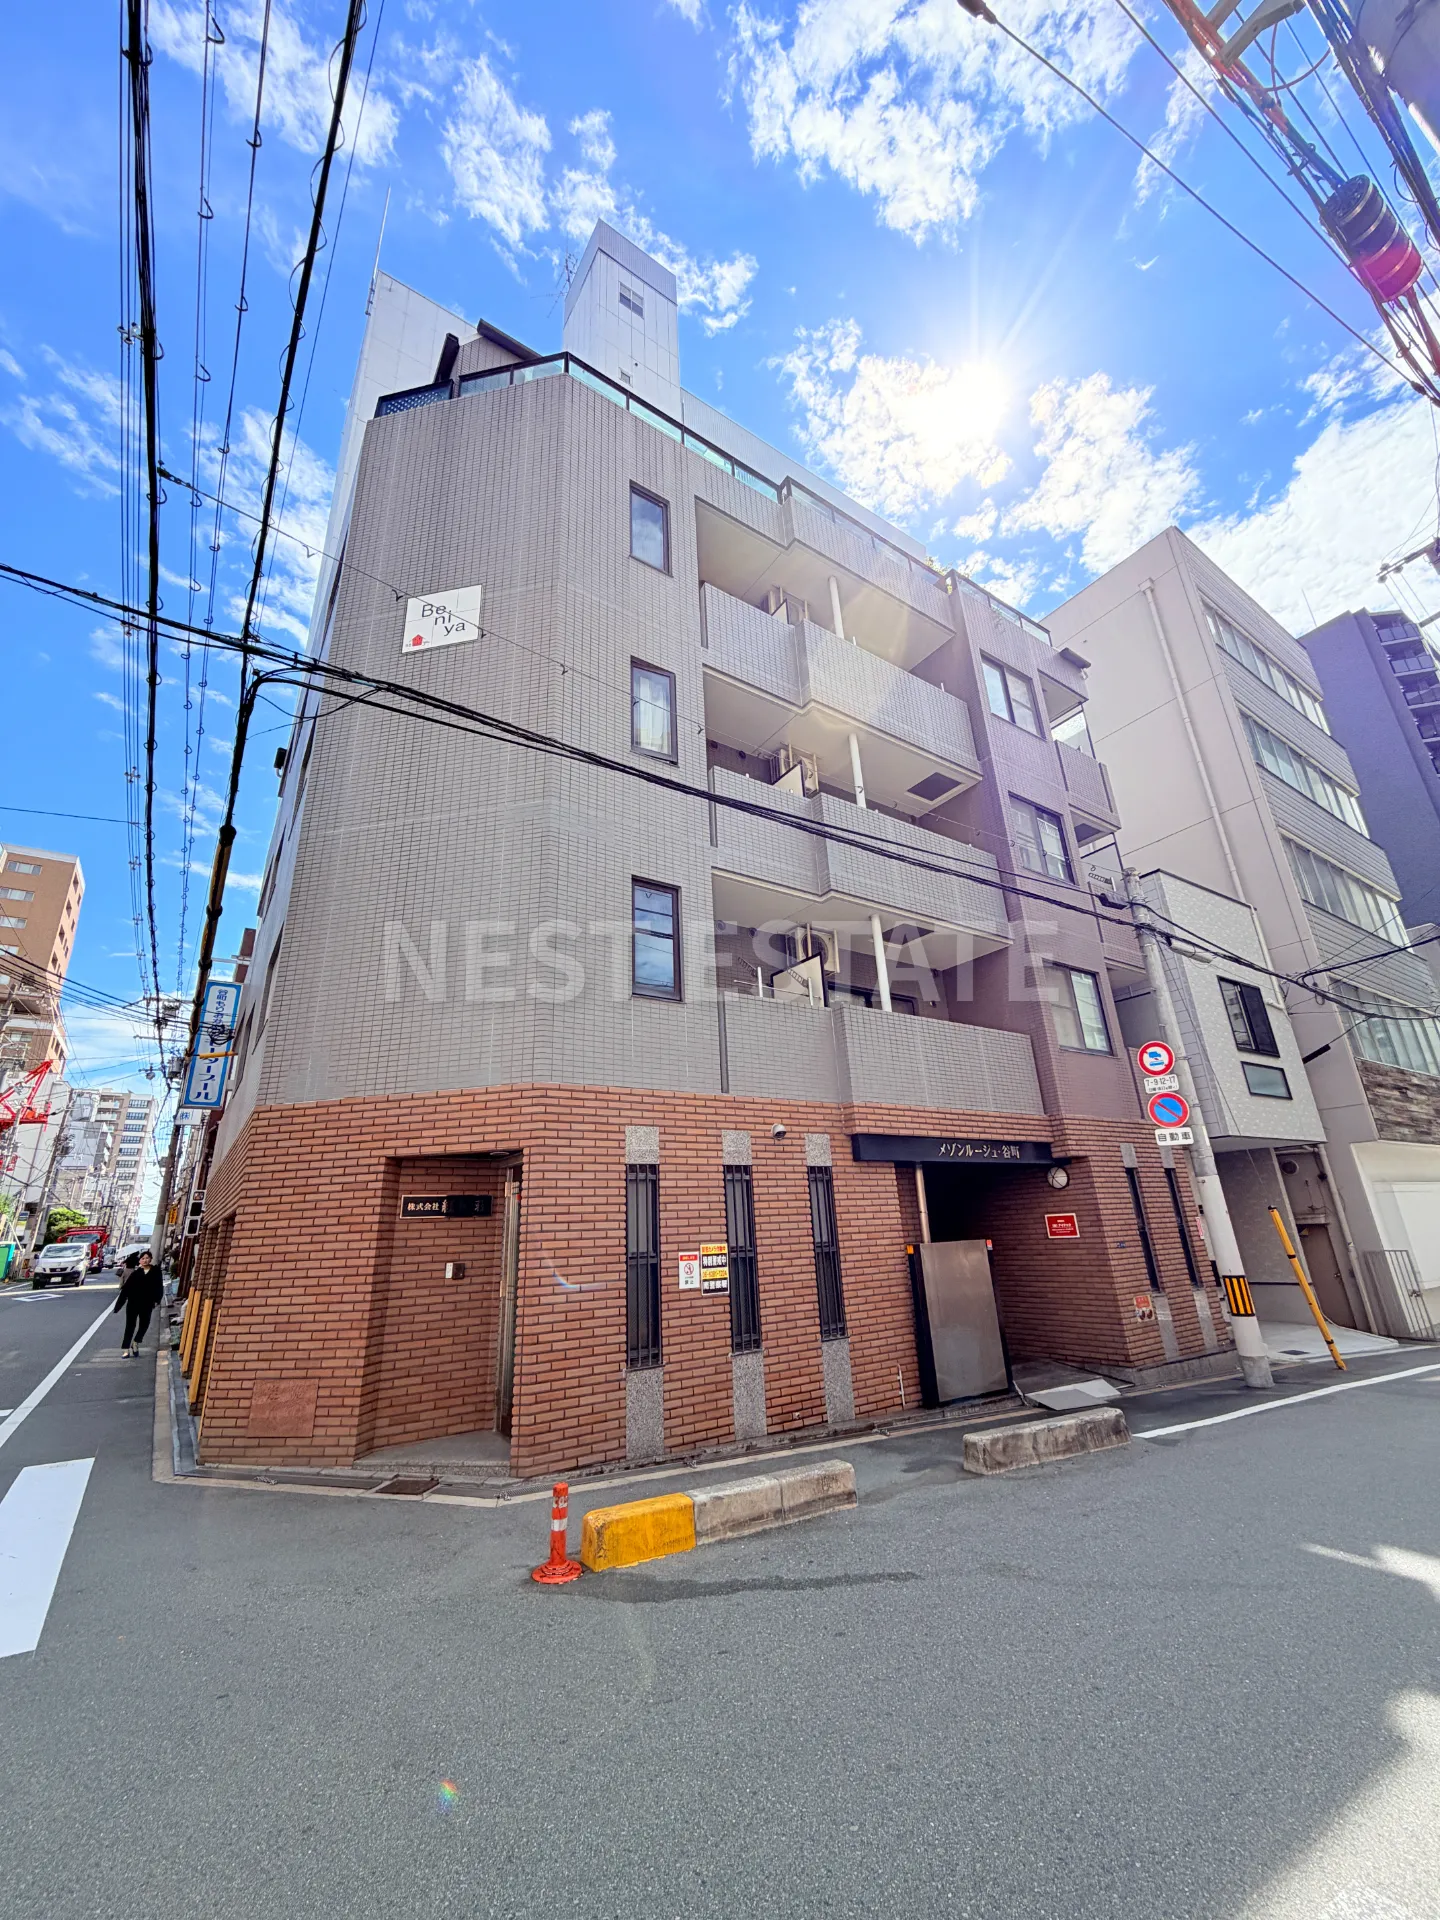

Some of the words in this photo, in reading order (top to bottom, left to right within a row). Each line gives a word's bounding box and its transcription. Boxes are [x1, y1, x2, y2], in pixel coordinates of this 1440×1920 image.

[421, 603, 447, 618] Be
[443, 622, 466, 637] ya
[1158, 1132, 1191, 1142] 自動車
